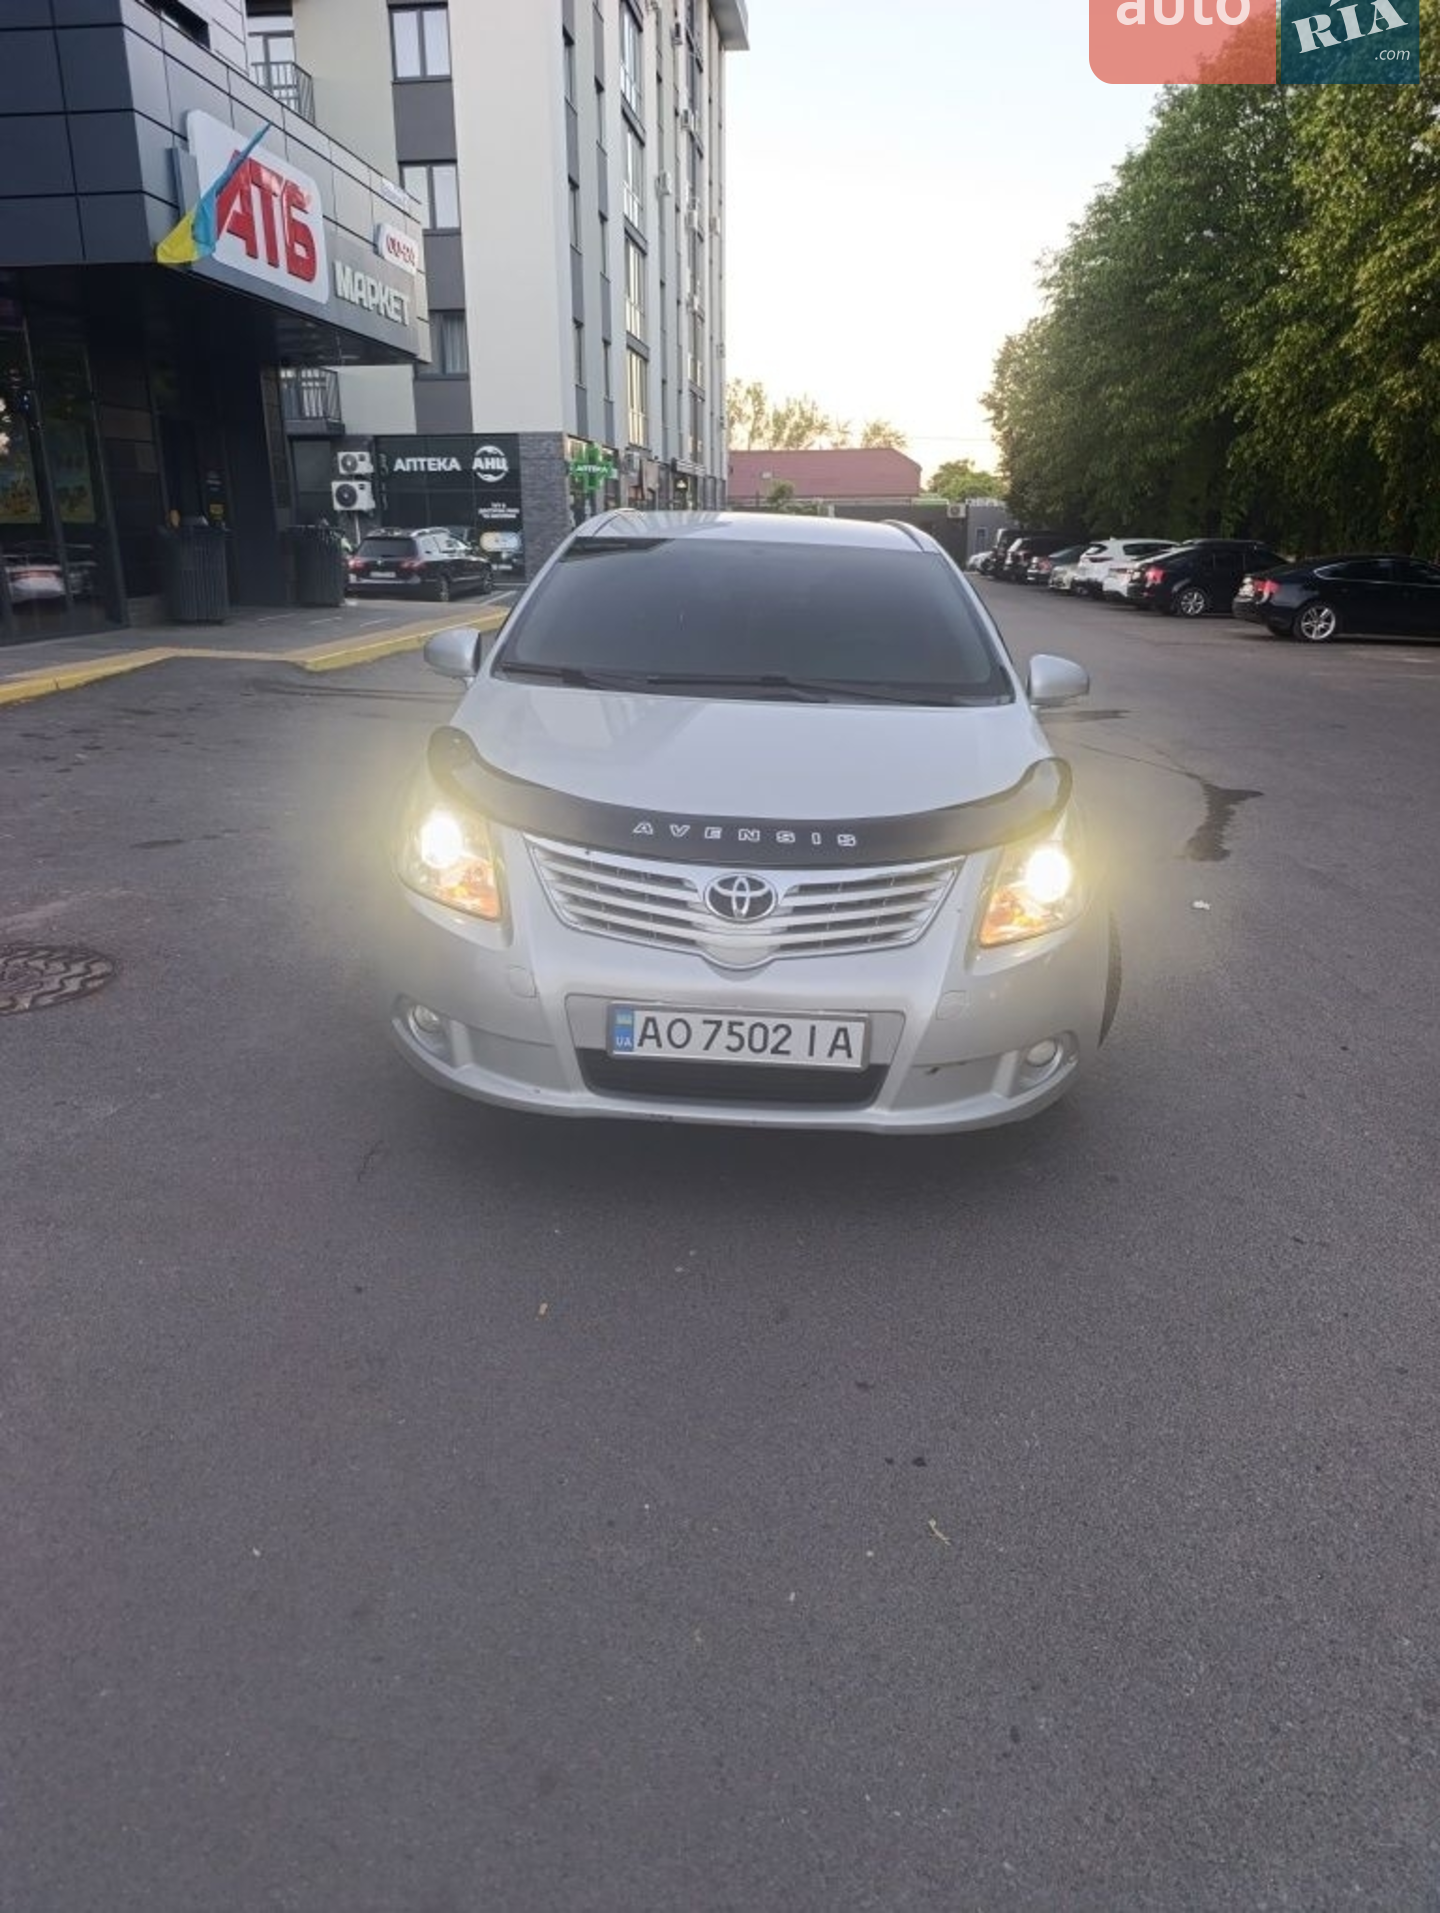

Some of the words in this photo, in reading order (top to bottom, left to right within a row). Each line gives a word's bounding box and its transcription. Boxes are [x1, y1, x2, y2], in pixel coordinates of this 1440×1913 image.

[216, 149, 318, 284] АТБ
[332, 260, 410, 327] МАРКЕТ
[393, 457, 462, 472] АПТЕКА
[472, 456, 509, 473] АНЦ
[576, 464, 608, 475] АПТЕКА
[632, 821, 857, 847] AVENSIS
[616, 1035, 632, 1047] UA
[637, 1016, 692, 1049] AO
[702, 1019, 792, 1056] 7502
[808, 1024, 853, 1059] IA
